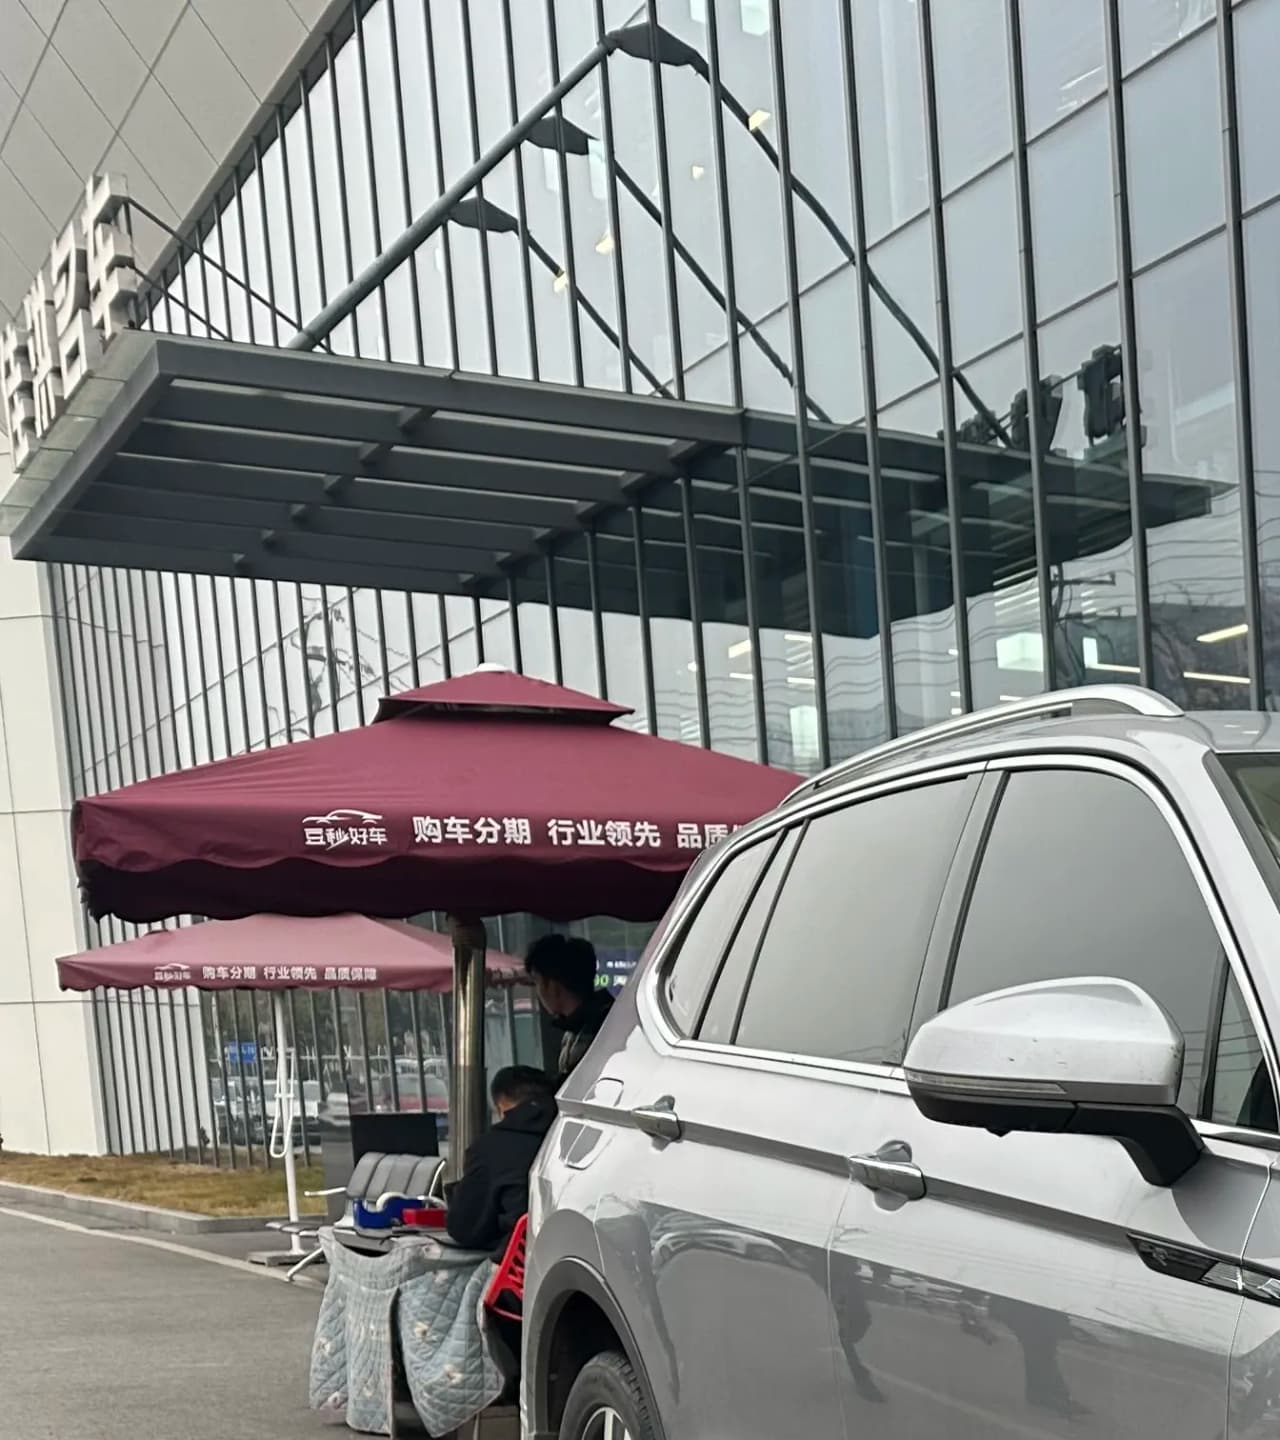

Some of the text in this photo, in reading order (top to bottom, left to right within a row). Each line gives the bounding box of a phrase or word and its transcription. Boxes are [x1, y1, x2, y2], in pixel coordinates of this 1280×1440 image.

[412, 816, 745, 850] 购车分期 行业领先 品质
[202, 966, 257, 980] 购车分期
